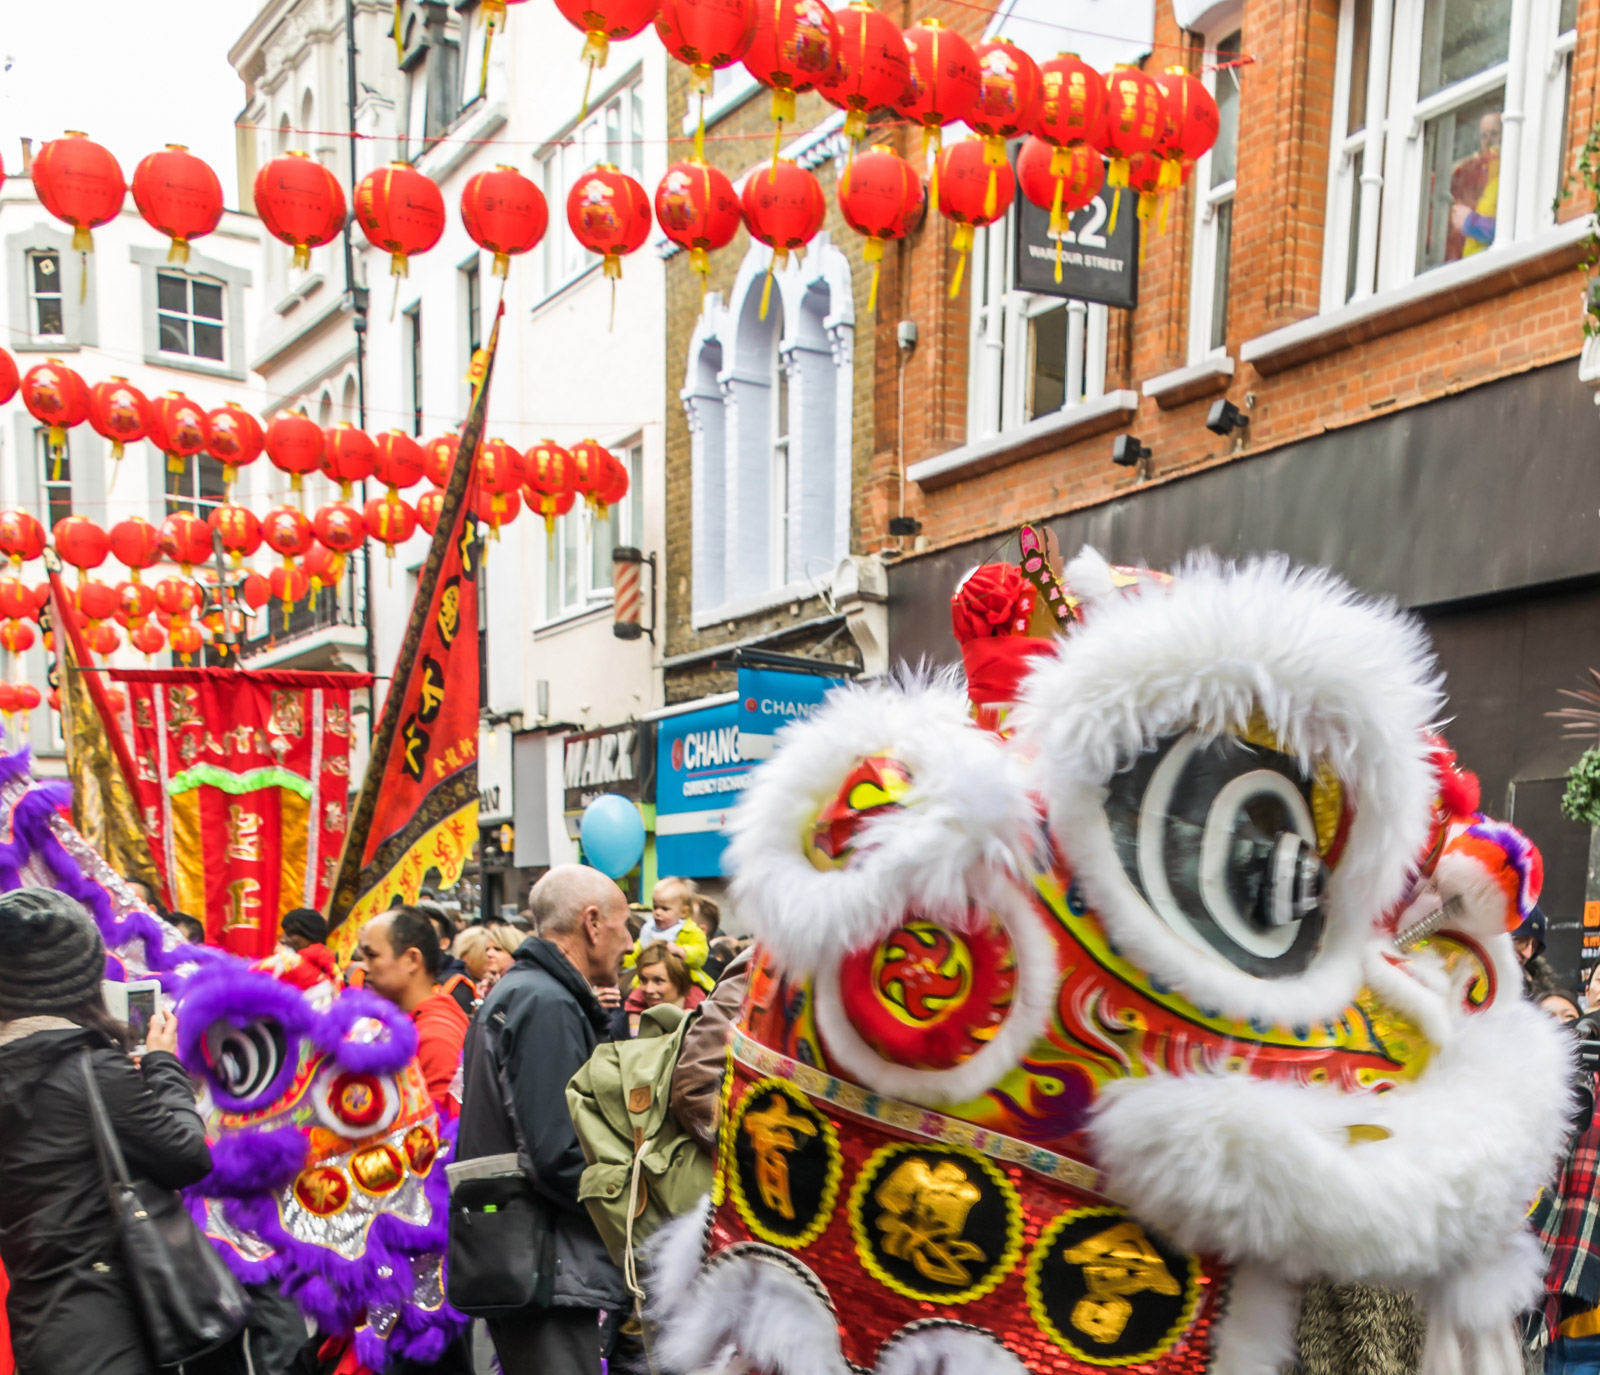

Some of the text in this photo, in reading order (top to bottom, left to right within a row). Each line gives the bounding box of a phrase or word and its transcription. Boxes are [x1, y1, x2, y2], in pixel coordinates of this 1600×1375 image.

[1028, 245, 1124, 272] WAROUR STREET
[564, 730, 633, 789] MARX
[683, 725, 741, 770] CHANG
[683, 777, 717, 797] CURRENCY
